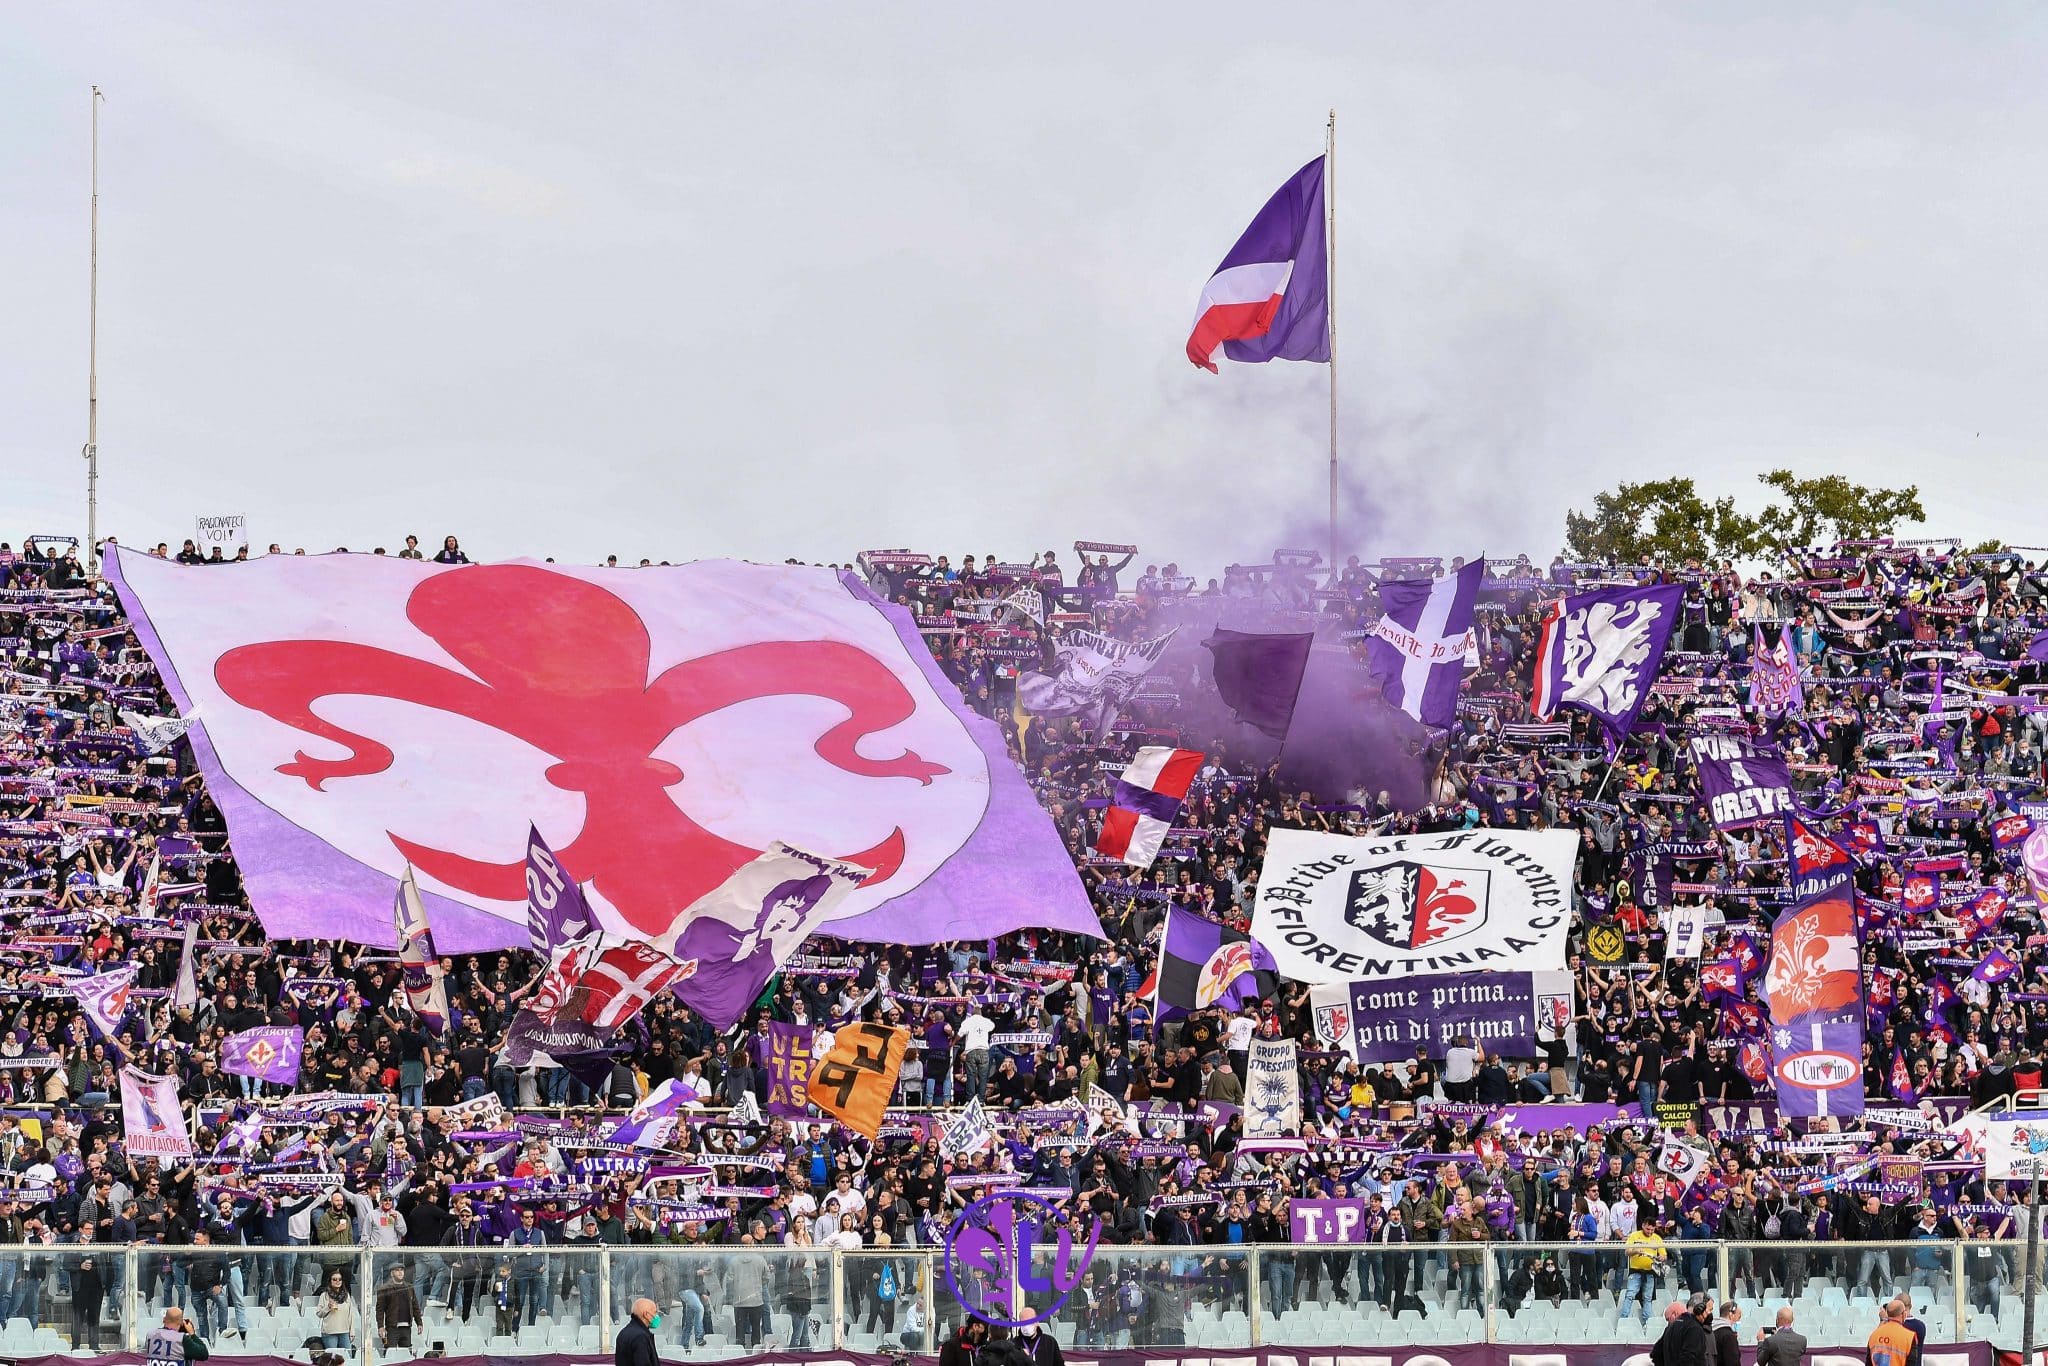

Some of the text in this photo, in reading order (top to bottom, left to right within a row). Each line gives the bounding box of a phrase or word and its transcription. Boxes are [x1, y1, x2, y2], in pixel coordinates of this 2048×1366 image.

[206, 529, 234, 546] VOI!
[1729, 761, 1754, 788] A
[1712, 787, 1796, 824] GREVE
[1368, 840, 1408, 855] of
[1424, 832, 1562, 908] Florence
[1270, 907, 1506, 977] FIORENTINA
[1356, 989, 1419, 1011] come
[1358, 1019, 1400, 1049] più
[1408, 1017, 1431, 1041] di
[1025, 1034, 1052, 1044] BELLO
[1256, 1045, 1290, 1058] GRUPPO
[1250, 1058, 1296, 1073] STRESSATO
[1437, 1104, 1489, 1113] FIORENTINA
[1656, 1102, 1698, 1111] CONTRO IL
[1663, 1112, 1692, 1120] CALCIO
[1659, 1120, 1687, 1128] MODER
[1889, 1116, 1928, 1128] MERDA
[127, 1134, 188, 1153] MONTAIONE
[556, 1137, 584, 1146] JUVE
[1043, 1135, 1091, 1145] FIORENTINA
[1143, 1147, 1182, 1155] FIORENTINA
[583, 1157, 647, 1172] ULTRAS
[699, 1154, 776, 1172] JUVE MERDA
[2010, 1159, 2032, 1170] AMICI
[1774, 1165, 1818, 1176] VILLANI
[264, 1174, 342, 1184] JUVE MERDA
[1854, 1183, 1905, 1193] VILLANI
[1163, 1194, 1212, 1204] FIORENTINA
[666, 1209, 731, 1220] VALDARNO
[1965, 1205, 2004, 1213] VILLANI
[1297, 1207, 1323, 1242] T
[1336, 1207, 1359, 1242] P
[152, 1339, 172, 1356] 21
